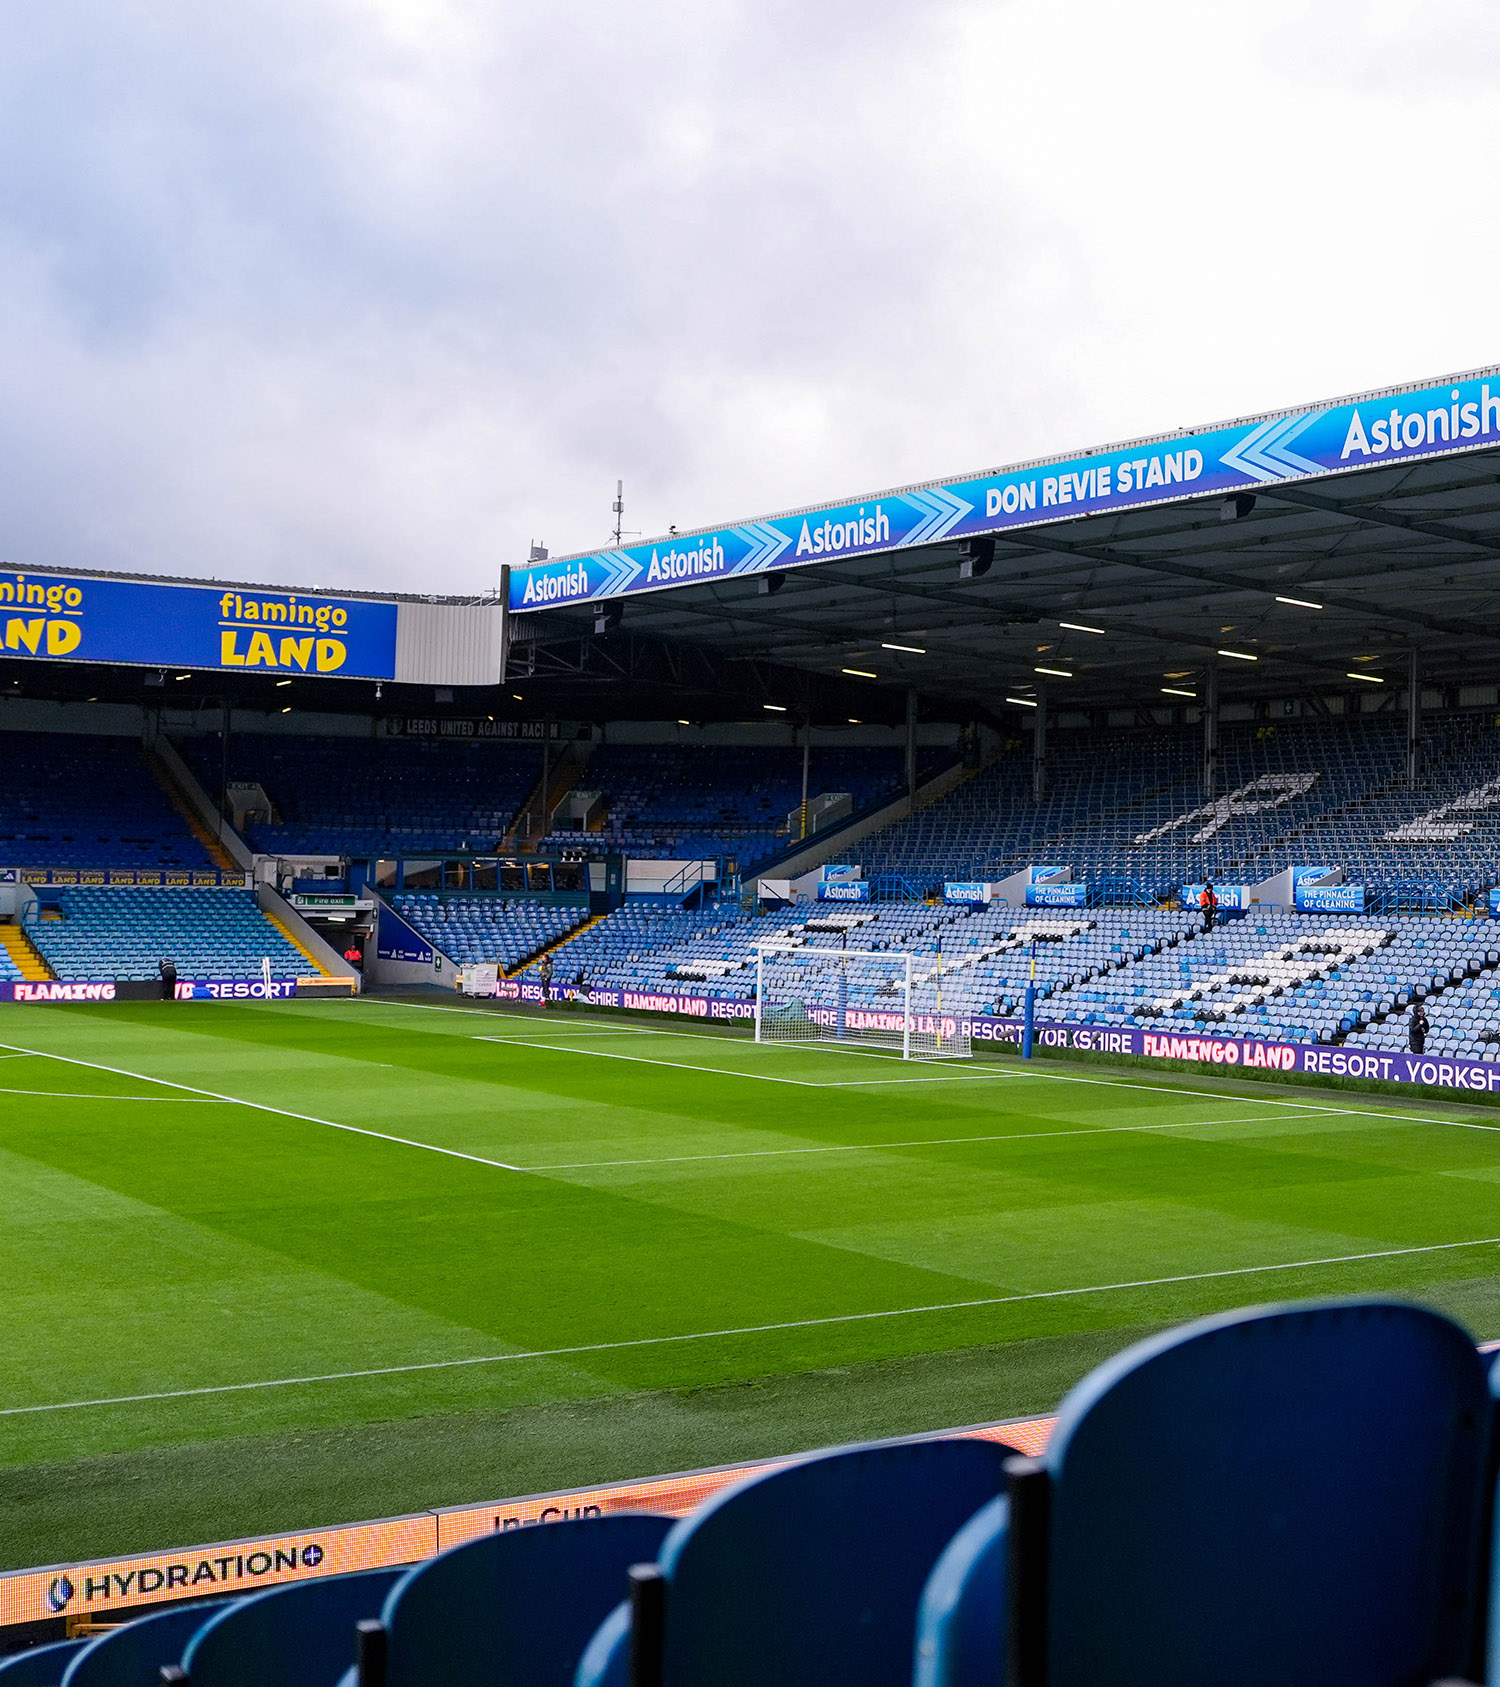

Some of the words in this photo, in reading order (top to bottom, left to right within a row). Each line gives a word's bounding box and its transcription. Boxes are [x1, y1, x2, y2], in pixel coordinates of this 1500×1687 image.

[986, 481, 1036, 517] DON
[1042, 466, 1111, 507] REVIE
[1116, 449, 1203, 493] STAND
[795, 505, 890, 556] Astonish
[647, 537, 724, 582] Astonish
[0, 575, 82, 613] mingo
[523, 563, 588, 604] Astonish
[219, 593, 348, 633] flamingo
[0, 618, 81, 655] ND
[221, 631, 347, 672] LAND
[407, 719, 437, 735] LEEDS
[440, 719, 473, 736] UNITED
[477, 721, 518, 737] AGAINST
[521, 722, 558, 738] RACIM
[824, 883, 861, 899] Astonish
[1304, 890, 1317, 898] THE
[1320, 890, 1355, 899] PINNACLE
[1304, 900, 1314, 908] OF
[1316, 900, 1355, 909] CLEANING
[624, 993, 677, 1012] FLAMINGO
[679, 997, 707, 1017] LAND
[1143, 1033, 1239, 1064] FLAMINGO
[1242, 1042, 1296, 1071] LAND
